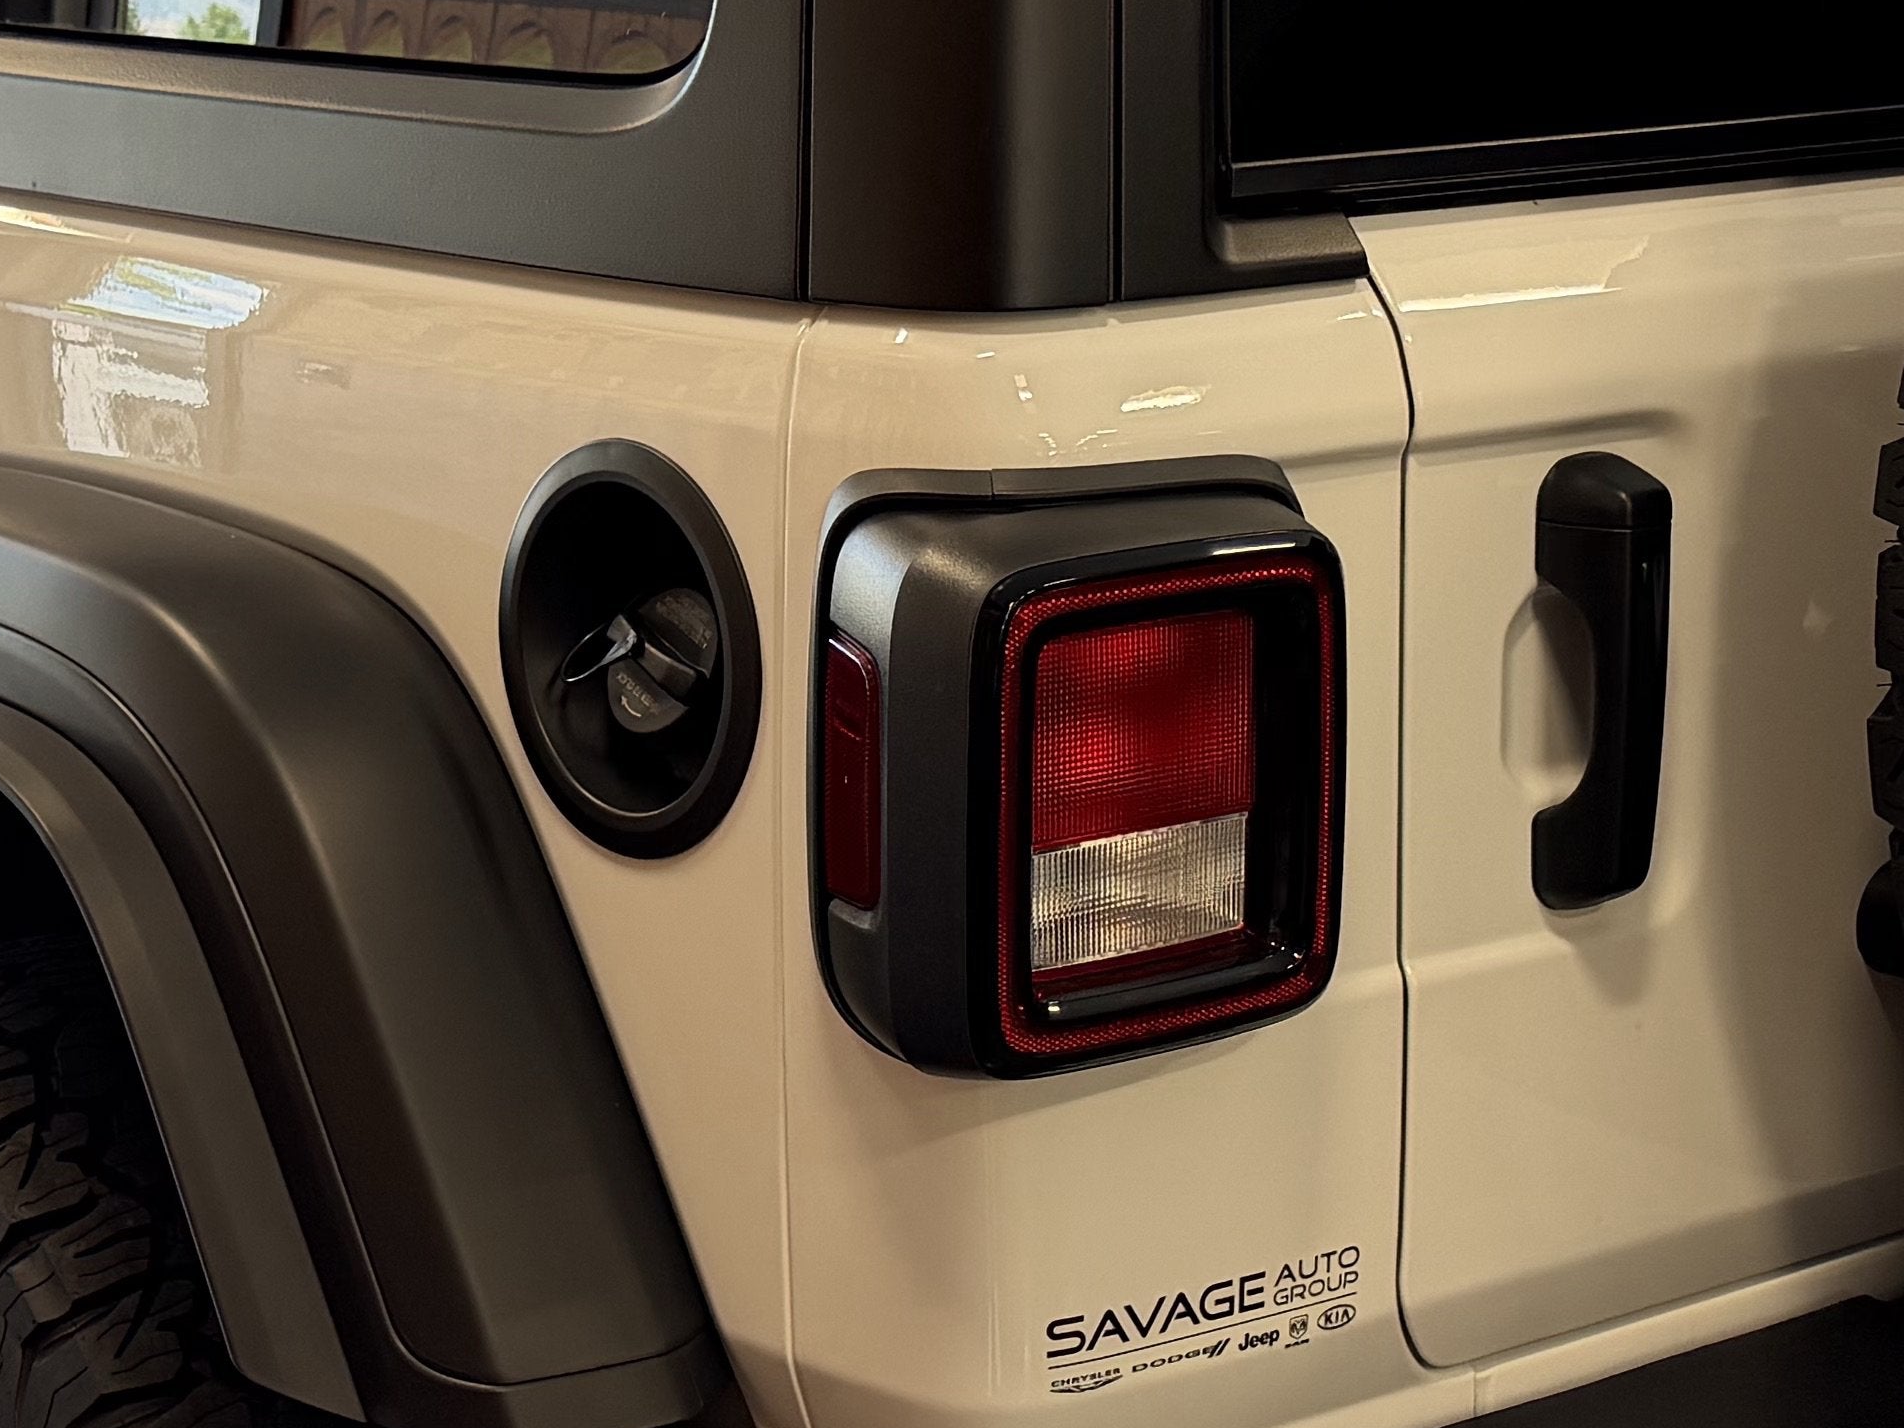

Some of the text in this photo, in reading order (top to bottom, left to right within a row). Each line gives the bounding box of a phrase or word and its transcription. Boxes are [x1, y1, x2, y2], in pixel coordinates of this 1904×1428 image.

[1274, 1245, 1360, 1288] AUTO
[1046, 1270, 1359, 1359] SAVAGE GROUP
[1050, 1367, 1121, 1389] CHRYSLER
[1238, 1329, 1280, 1352] Jeep
[1322, 1306, 1352, 1326] KIA
